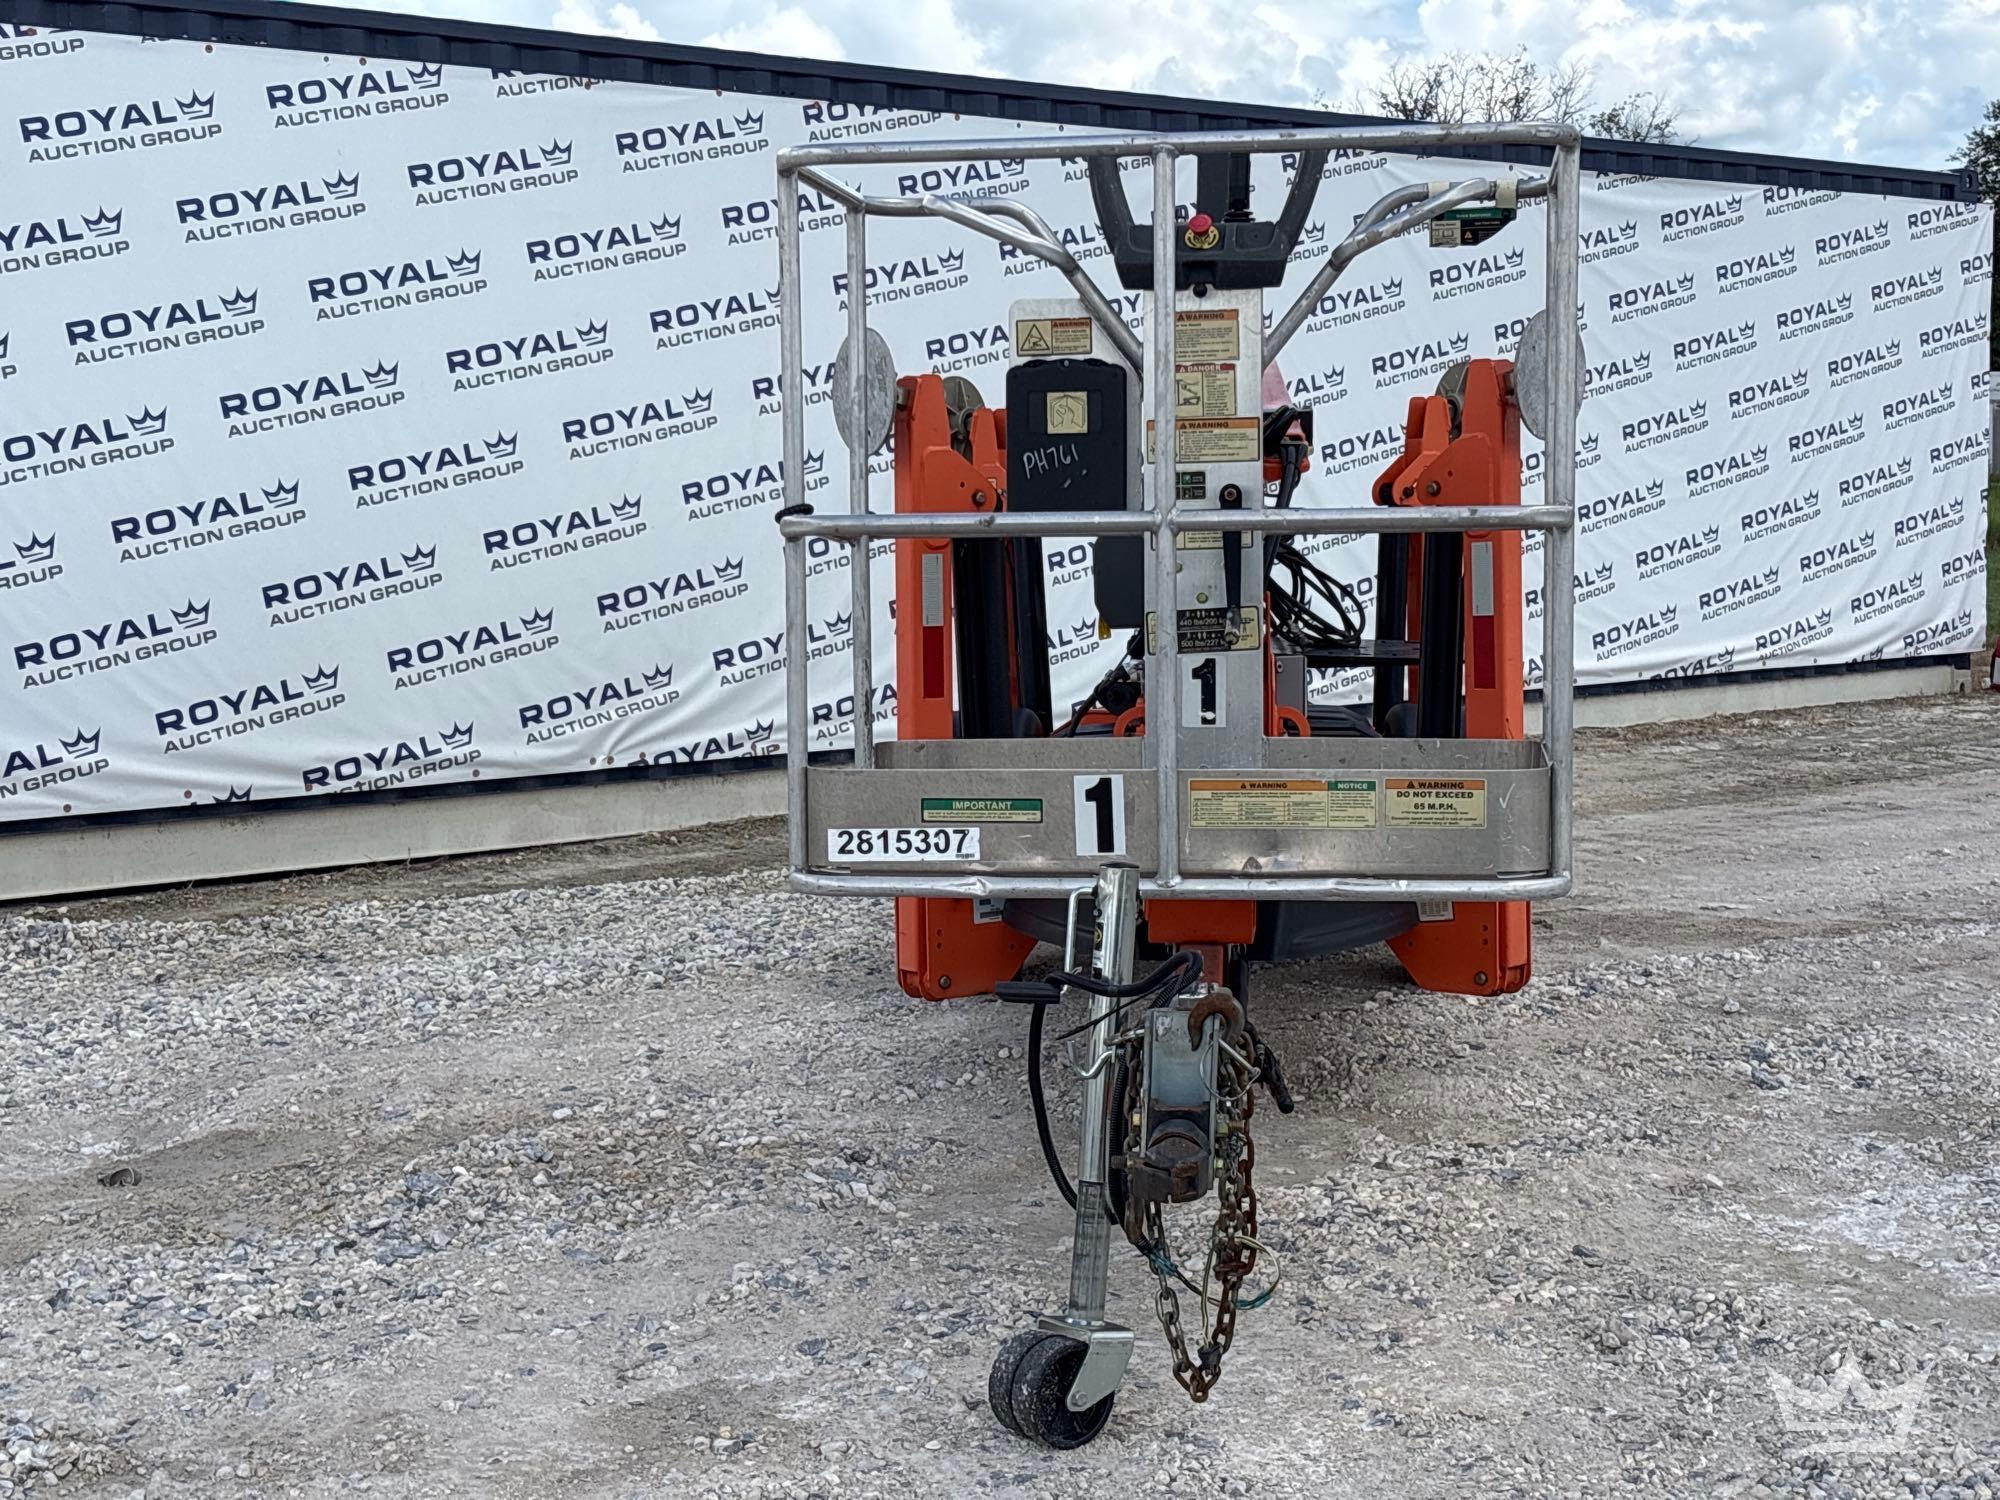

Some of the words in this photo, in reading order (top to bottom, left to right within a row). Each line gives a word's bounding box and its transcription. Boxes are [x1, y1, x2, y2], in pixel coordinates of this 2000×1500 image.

[265, 71, 409, 109] ROYAL
[18, 100, 178, 142] ROYAL
[274, 104, 371, 128] AUCTION
[375, 94, 449, 115] GROUP
[28, 135, 136, 162] AUCTION
[141, 124, 223, 147] GROUP
[615, 118, 736, 154] ROYAL
[408, 149, 542, 188] ROYAL
[622, 149, 704, 172] AUCTION
[707, 139, 770, 159] GROUP
[416, 181, 507, 206] AUCTION
[510, 170, 579, 192] GROUP
[897, 161, 1001, 195] ROYAL
[976, 179, 1030, 199] GROUP
[176, 181, 325, 224] ROYAL
[1660, 201, 1727, 230] ROYAL
[185, 215, 286, 243] AUCTION
[290, 203, 367, 227] GROUP
[1663, 223, 1709, 243] AUCTION
[1710, 214, 1745, 231] GROUP
[526, 223, 652, 263] ROYAL
[1815, 227, 1875, 255] ROYAL
[1817, 248, 1859, 267] AUCTION
[1860, 239, 1892, 255] GROUP
[534, 255, 619, 281] AUCTION
[622, 243, 688, 265] GROUP
[1429, 256, 1505, 288] ROYAL
[1716, 253, 1780, 282] ROYAL
[1719, 275, 1763, 294] AUCTION
[1764, 265, 1798, 282] GROUP
[308, 259, 448, 302] ROYAL
[1432, 280, 1484, 302] AUCTION
[1486, 270, 1526, 288] GROUP
[1609, 279, 1678, 310] ROYAL
[1870, 272, 1928, 301] ROYAL
[1872, 294, 1912, 312] AUCTION
[1914, 284, 1944, 300] GROUP
[316, 293, 411, 321] AUCTION
[415, 279, 487, 303] GROUP
[1612, 302, 1659, 323] AUCTION
[1661, 292, 1697, 310] GROUP
[1776, 299, 1838, 329] ROYAL
[64, 299, 221, 346] ROYAL
[1779, 321, 1821, 341] AUCTION
[1822, 312, 1855, 328] GROUP
[74, 334, 180, 366] AUCTION
[184, 320, 265, 346] GROUP
[446, 330, 577, 373] ROYAL
[1371, 341, 1450, 375] ROYAL
[1673, 328, 1739, 359] ROYAL
[1675, 351, 1720, 372] AUCTION
[1722, 340, 1756, 358] GROUP
[454, 362, 543, 391] AUCTION
[546, 348, 614, 372] GROUP
[1187, 364, 1221, 372] DANGER
[1375, 366, 1429, 389] AUCTION
[1826, 347, 1886, 376] ROYAL
[1829, 368, 1870, 388] AUCTION
[1871, 358, 1902, 375] GROUP
[219, 372, 365, 419] ROYAL
[1729, 376, 1792, 408] ROYAL
[1731, 399, 1775, 420] AUCTION
[1776, 388, 1810, 406] GROUP
[1882, 390, 1940, 420] ROYAL
[228, 406, 327, 438] AUCTION
[331, 391, 406, 417] GROUP
[562, 398, 685, 442] ROYAL
[1188, 421, 1229, 429] WARNING
[1622, 408, 1690, 441] ROYAL
[1885, 411, 1924, 431] AUCTION
[1925, 401, 1955, 418] GROUP
[569, 430, 653, 460] AUCTION
[656, 415, 720, 440] GROUP
[1625, 431, 1671, 453] AUCTION
[1673, 420, 1708, 438] GROUP
[1788, 420, 1849, 452] ROYAL
[1791, 442, 1833, 464] AUCTION
[1834, 431, 1866, 449] GROUP
[348, 443, 485, 491] ROYAL
[1023, 443, 1079, 479] PH761
[1686, 453, 1751, 486] ROYAL
[356, 477, 449, 509] AUCTION
[452, 460, 523, 487] GROUP
[1689, 475, 1733, 498] AUCTION
[1735, 464, 1769, 482] GROUP
[1838, 464, 1897, 496] ROYAL
[1840, 486, 1881, 507] AUCTION
[1882, 475, 1913, 492] GROUP
[111, 491, 264, 543] ROYAL
[1577, 487, 1646, 522] ROYAL
[1580, 511, 1627, 535] AUCTION
[1629, 499, 1665, 518] GROUP
[1741, 498, 1804, 531] ROYAL
[120, 527, 224, 563] AUCTION
[228, 509, 306, 538] GROUP
[484, 506, 612, 554] ROYAL
[1744, 521, 1787, 543] AUCTION
[1788, 509, 1821, 527] GROUP
[491, 539, 578, 572] AUCTION
[581, 522, 648, 549] GROUP
[1636, 534, 1703, 569] ROYAL
[1639, 557, 1685, 581] AUCTION
[1686, 544, 1721, 564] GROUP
[1799, 538, 1860, 572] ROYAL
[261, 556, 403, 609] ROYAL
[1802, 561, 1843, 583] AUCTION
[1844, 549, 1876, 567] GROUP
[269, 591, 366, 627] AUCTION
[370, 573, 443, 601] GROUP
[596, 568, 717, 616] ROYAL
[603, 600, 685, 633] AUCTION
[688, 582, 751, 609] GROUP
[1699, 575, 1763, 610] ROYAL
[1702, 598, 1746, 622] AUCTION
[1747, 586, 1781, 605] GROUP
[13, 613, 172, 670] ROYAL
[387, 621, 521, 673] ROYAL
[1592, 613, 1661, 650] ROYAL
[1595, 637, 1642, 662] AUCTION
[1644, 623, 1679, 643] GROUP
[23, 651, 131, 690] AUCTION
[135, 630, 217, 661] GROUP
[395, 655, 486, 691] AUCTION
[489, 635, 559, 664] GROUP
[155, 678, 304, 735] ROYAL
[519, 676, 645, 729] ROYAL
[1191, 658, 1216, 725] 1
[164, 715, 265, 754] AUCTION
[269, 693, 346, 724] GROUP
[527, 710, 612, 746] AUCTION
[615, 690, 680, 719] GROUP
[952, 800, 1013, 811] IMPORTANT
[1414, 802, 1425, 810] 65
[1435, 791, 1474, 799] EXCEED
[1085, 777, 1114, 853] 1
[837, 828, 970, 855] 2815307
